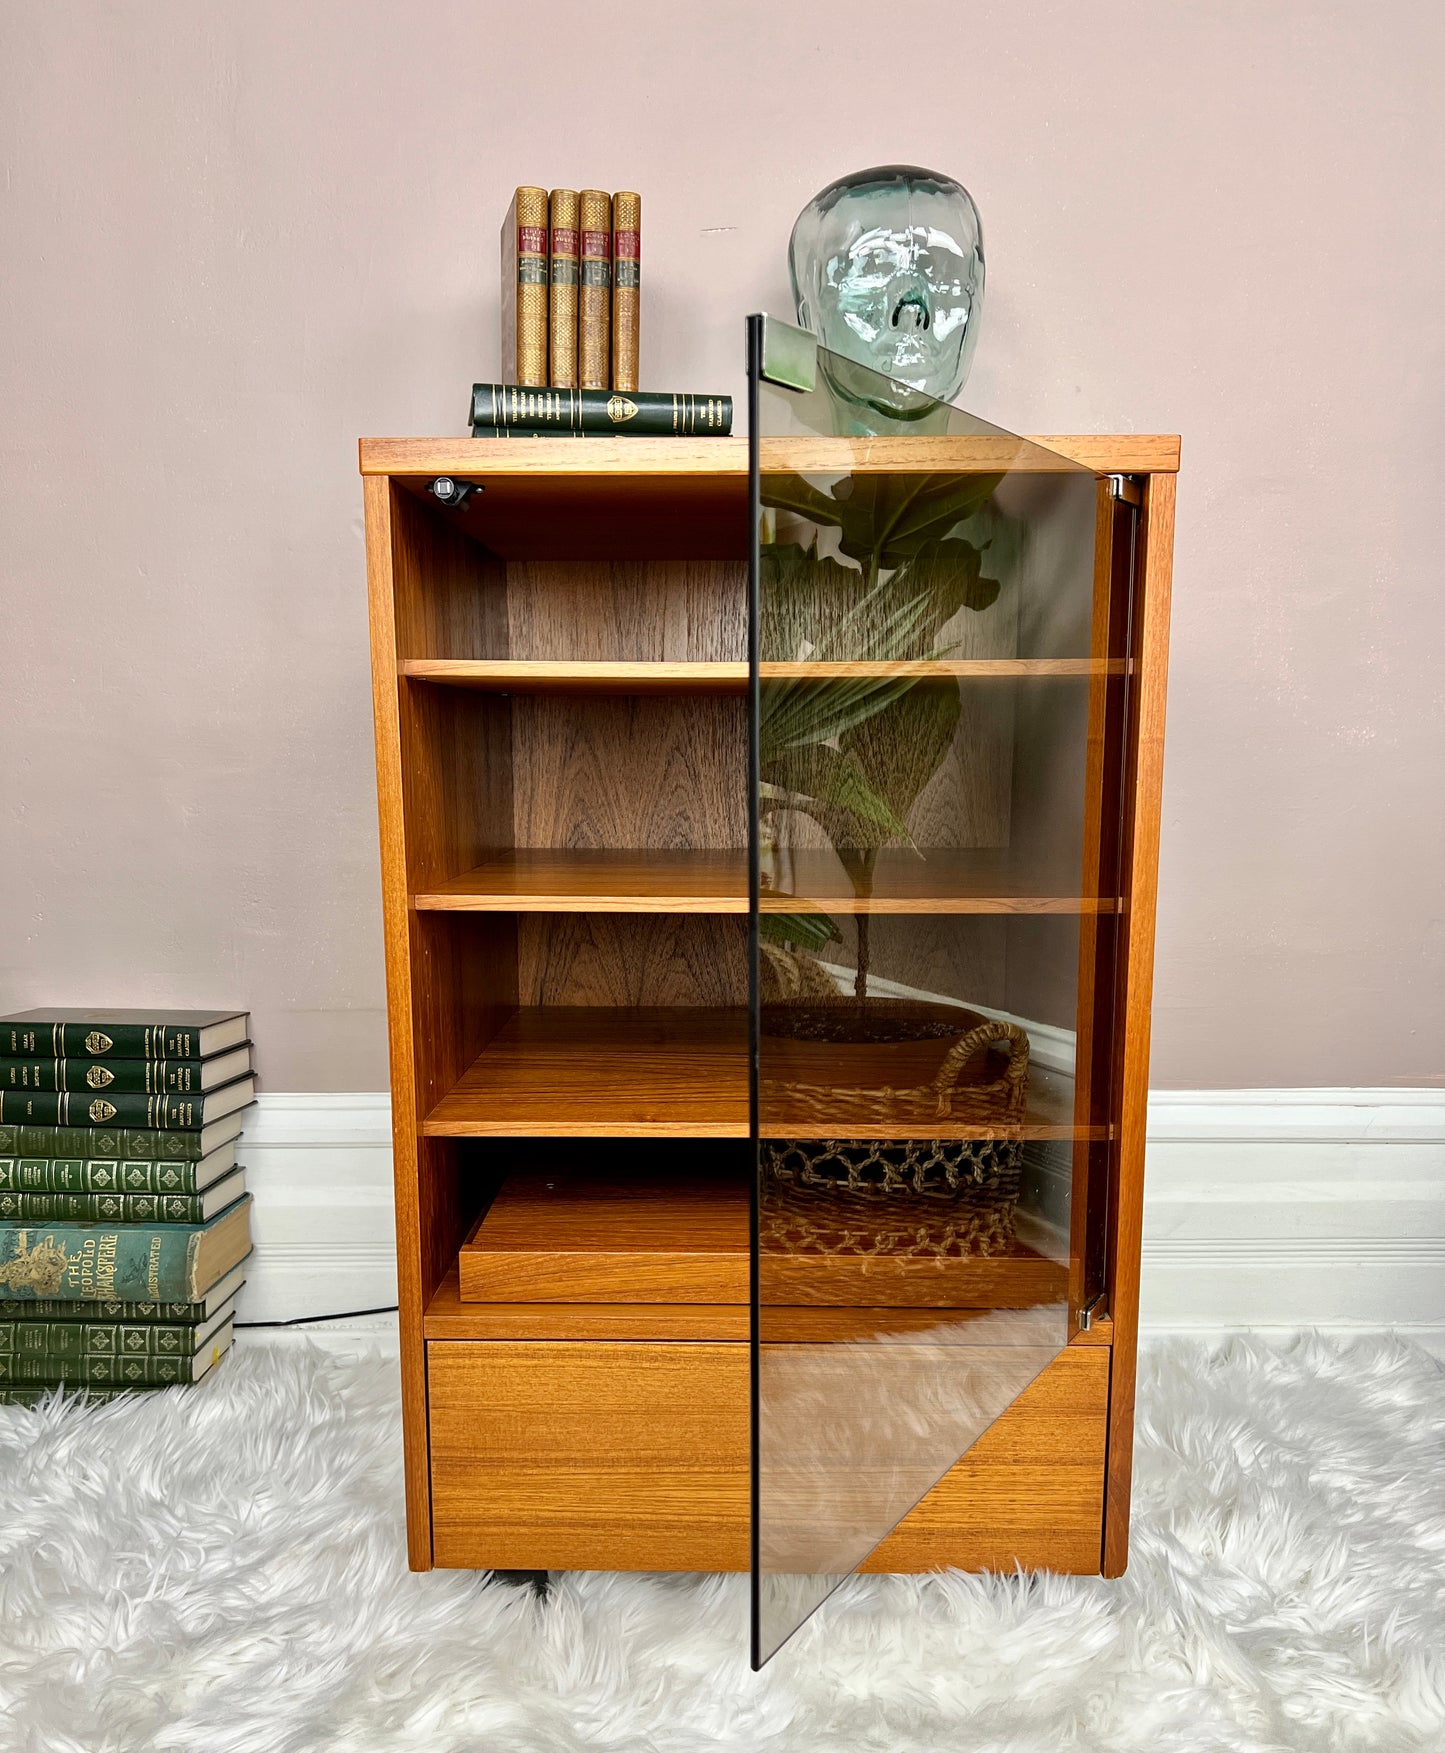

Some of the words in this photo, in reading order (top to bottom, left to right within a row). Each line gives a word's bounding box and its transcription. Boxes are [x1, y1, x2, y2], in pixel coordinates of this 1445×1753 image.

[68, 1250, 82, 1287] THE
[80, 1239, 96, 1298] LEOPOLD
[96, 1234, 121, 1301] SHAKSPERE
[147, 1237, 161, 1301] ILLUSTRATED
